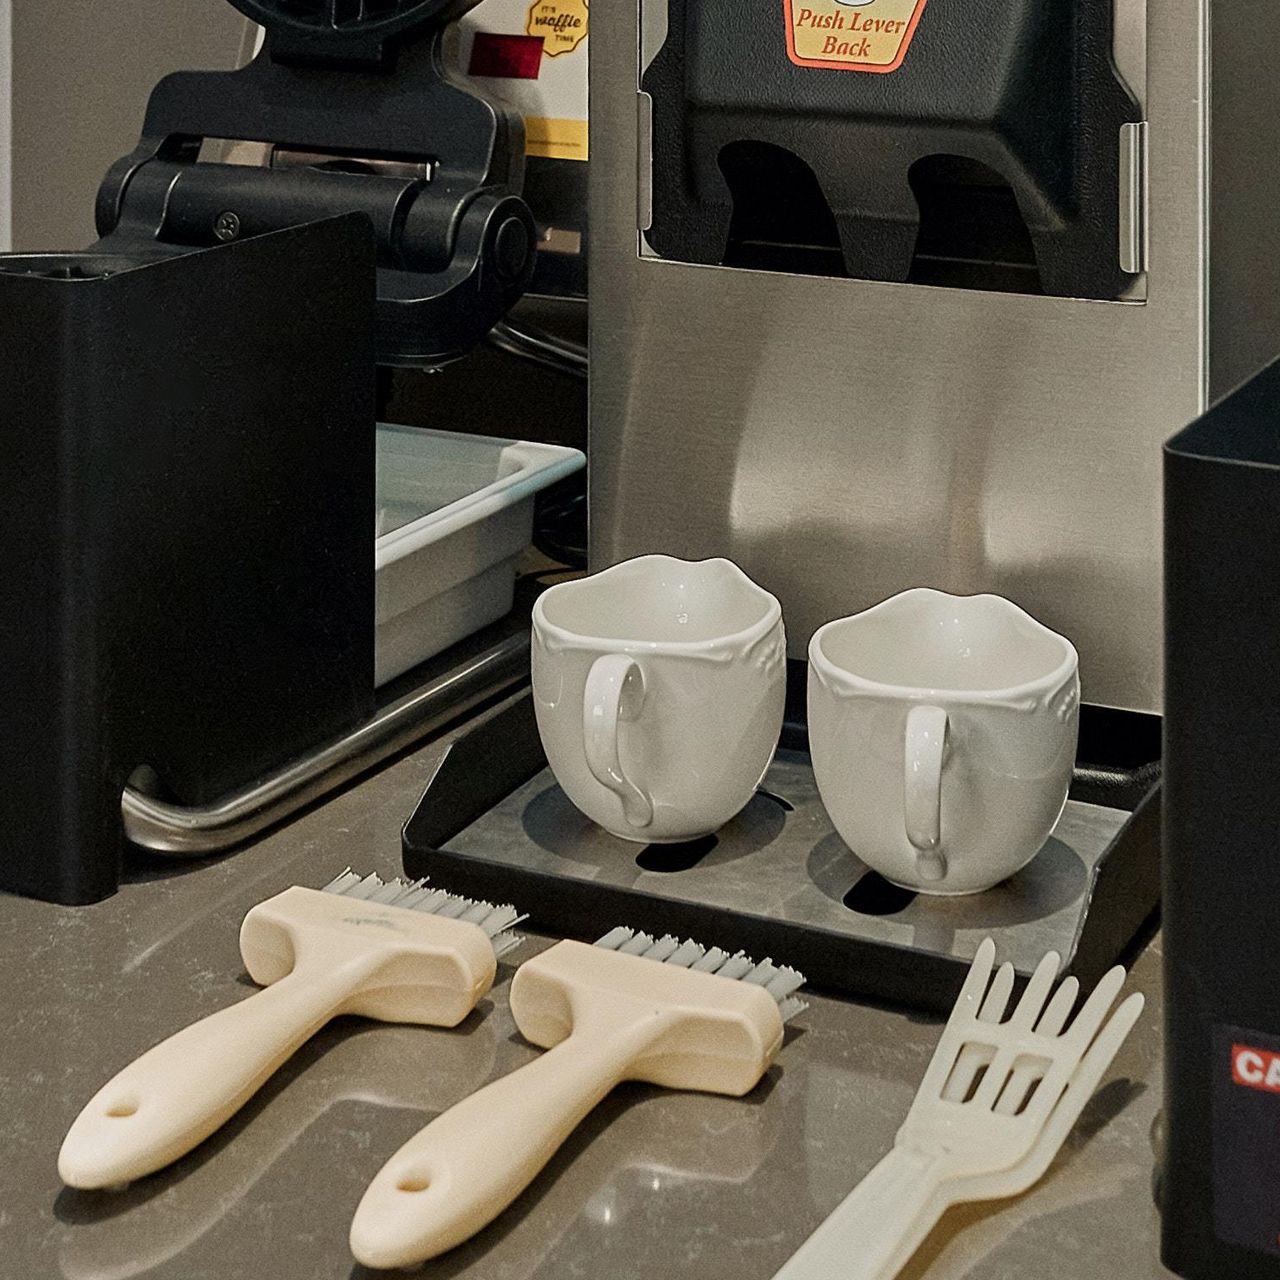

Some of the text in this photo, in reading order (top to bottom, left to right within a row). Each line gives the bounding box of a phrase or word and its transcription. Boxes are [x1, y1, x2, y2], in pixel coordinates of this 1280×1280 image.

[535, 14, 581, 32] waffle
[796, 8, 907, 35] Push Lever
[821, 35, 871, 57] Back
